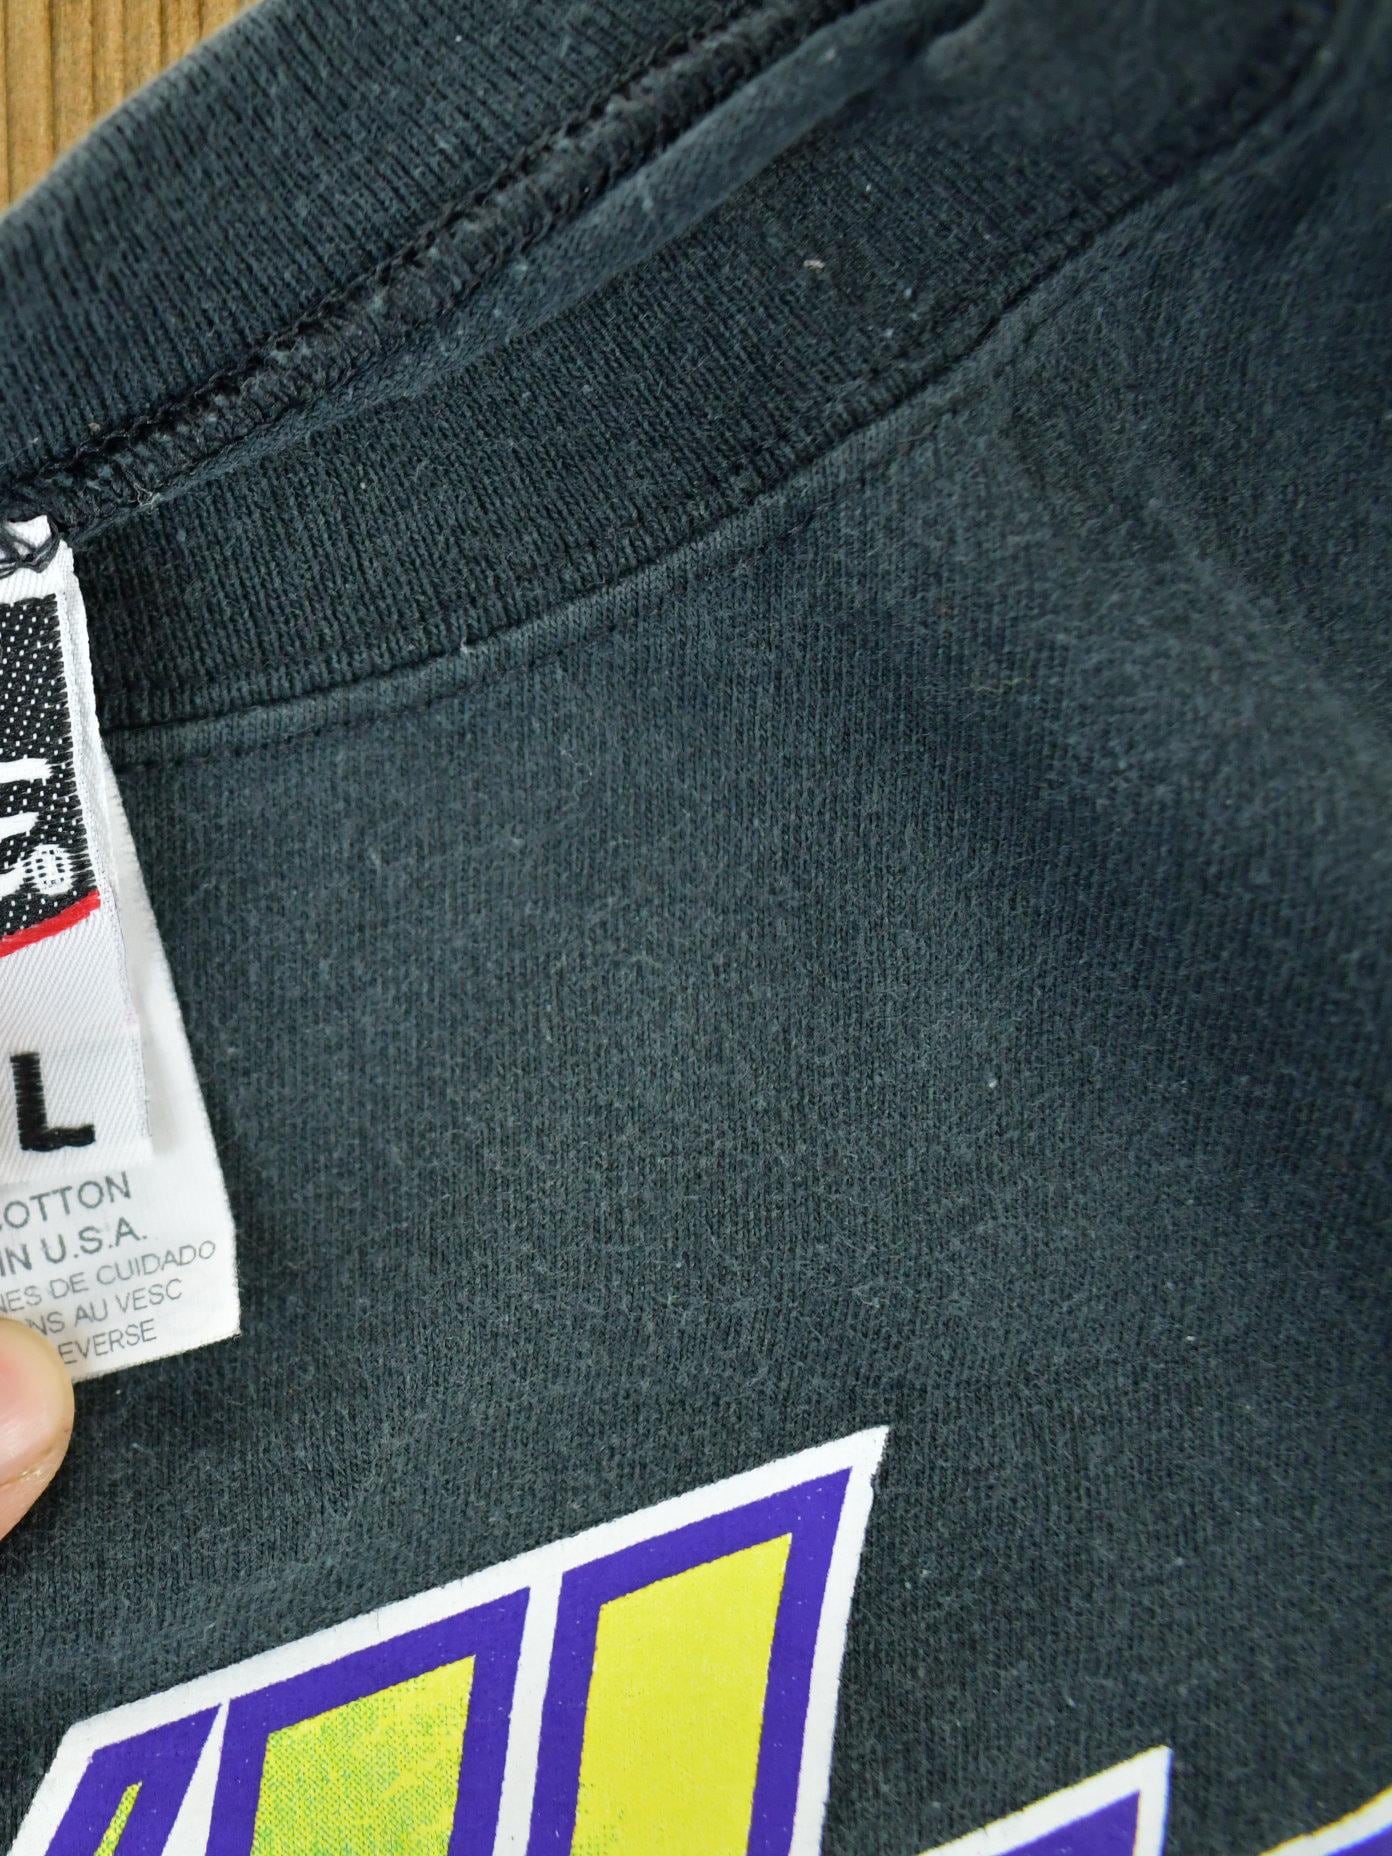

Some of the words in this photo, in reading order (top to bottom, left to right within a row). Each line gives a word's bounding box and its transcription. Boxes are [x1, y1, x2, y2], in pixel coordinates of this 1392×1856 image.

[11, 1051, 96, 1152] L
[40, 1216, 148, 1264] U.S.A.
[49, 1271, 89, 1300] DE
[96, 1240, 216, 1285] CUIDADO
[74, 1298, 108, 1327] AU
[115, 1278, 183, 1313] VESC
[58, 1318, 157, 1365] EVERSE
